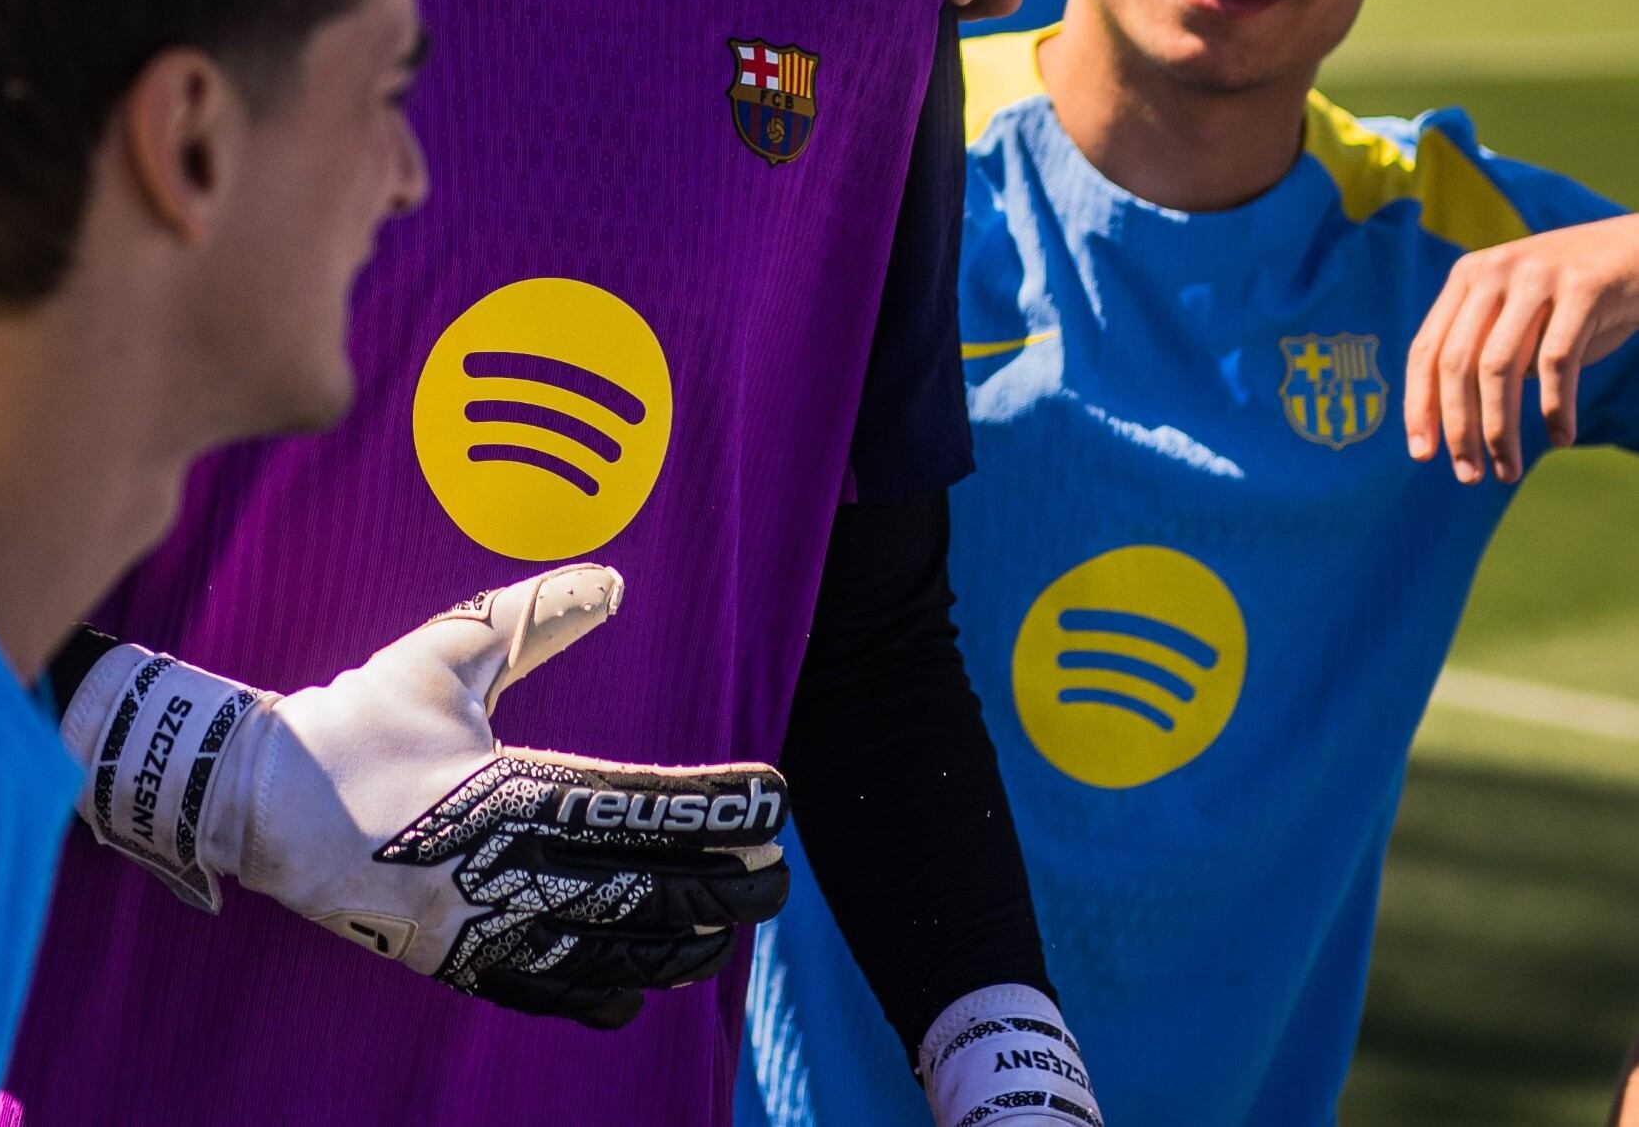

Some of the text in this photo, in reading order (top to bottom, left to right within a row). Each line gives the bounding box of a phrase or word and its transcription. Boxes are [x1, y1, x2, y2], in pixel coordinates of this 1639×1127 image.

[759, 89, 795, 110] FCB
[132, 695, 193, 844] SZCZĘSNY
[556, 777, 781, 832] reusch
[994, 1047, 1095, 1097] ZCZĘSNY
